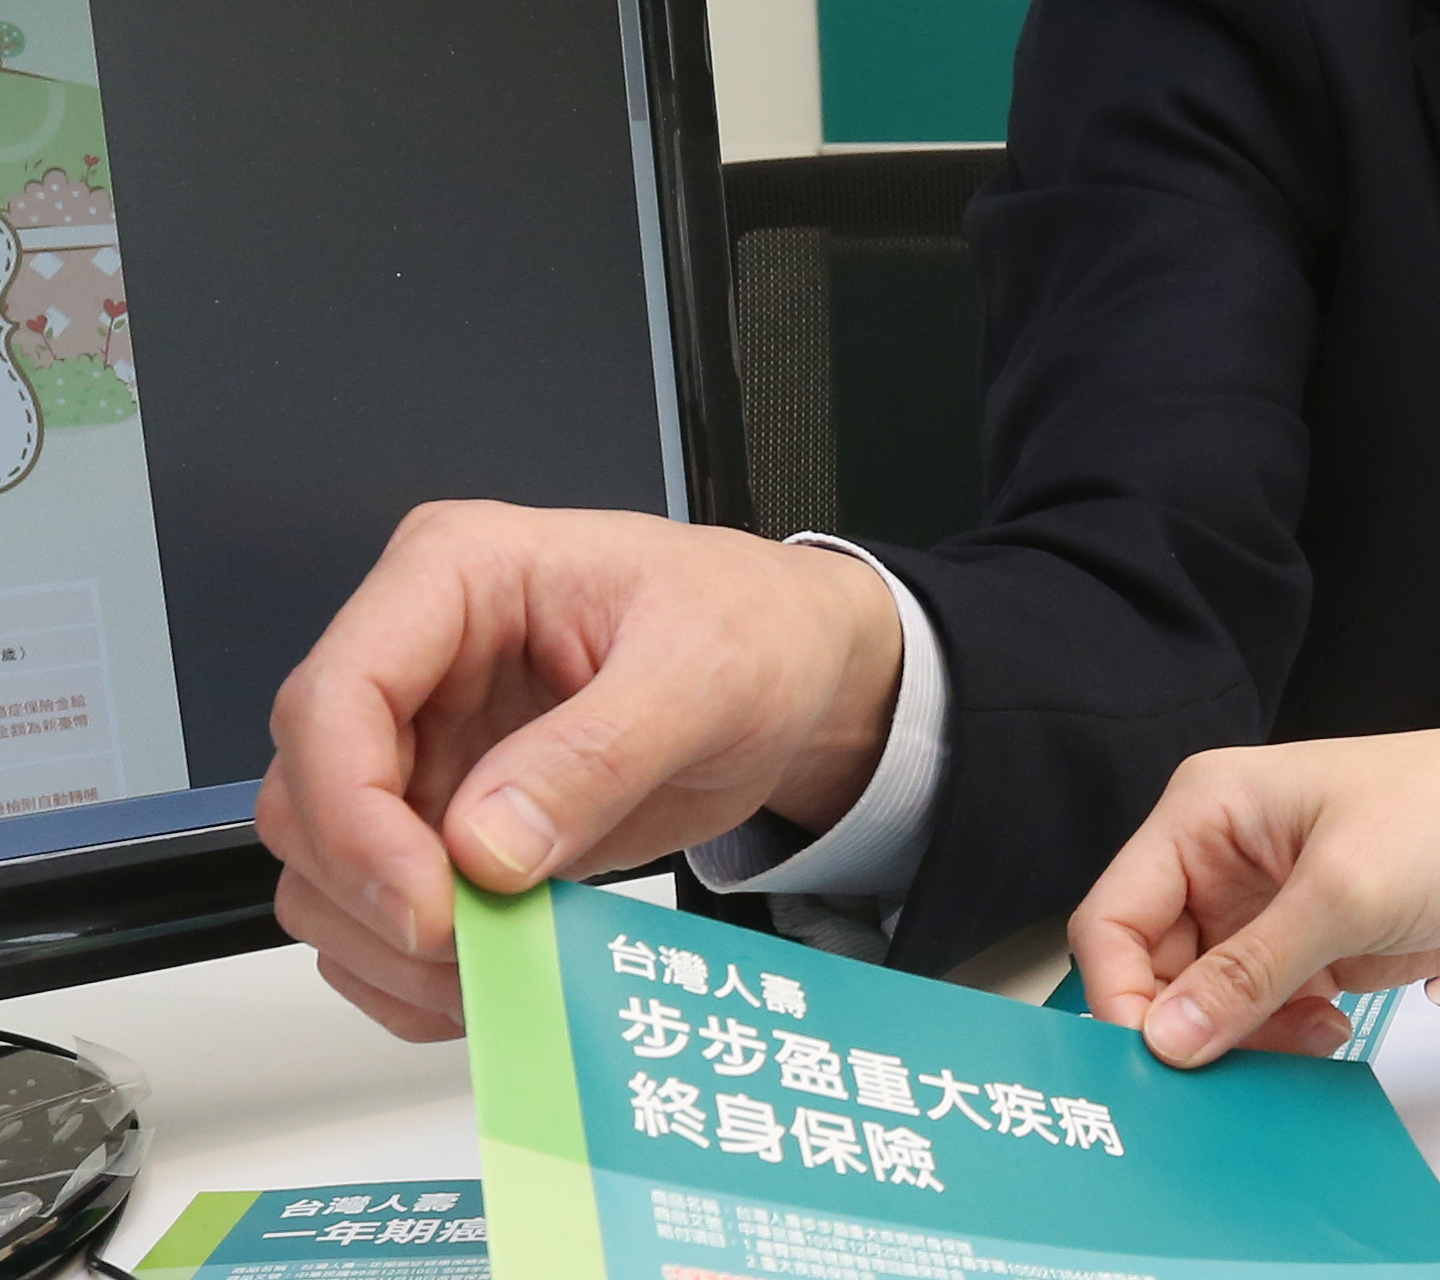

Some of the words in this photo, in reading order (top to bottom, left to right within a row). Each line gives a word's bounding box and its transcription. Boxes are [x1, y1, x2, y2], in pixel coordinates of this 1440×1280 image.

[606, 933, 809, 1019] 台灣人壽
[618, 996, 1127, 1158] 步步盈重大疾病
[626, 1070, 947, 1194] 終身保險
[262, 1217, 489, 1247] 一年期癌
[279, 1189, 463, 1220] 台灣人壽
